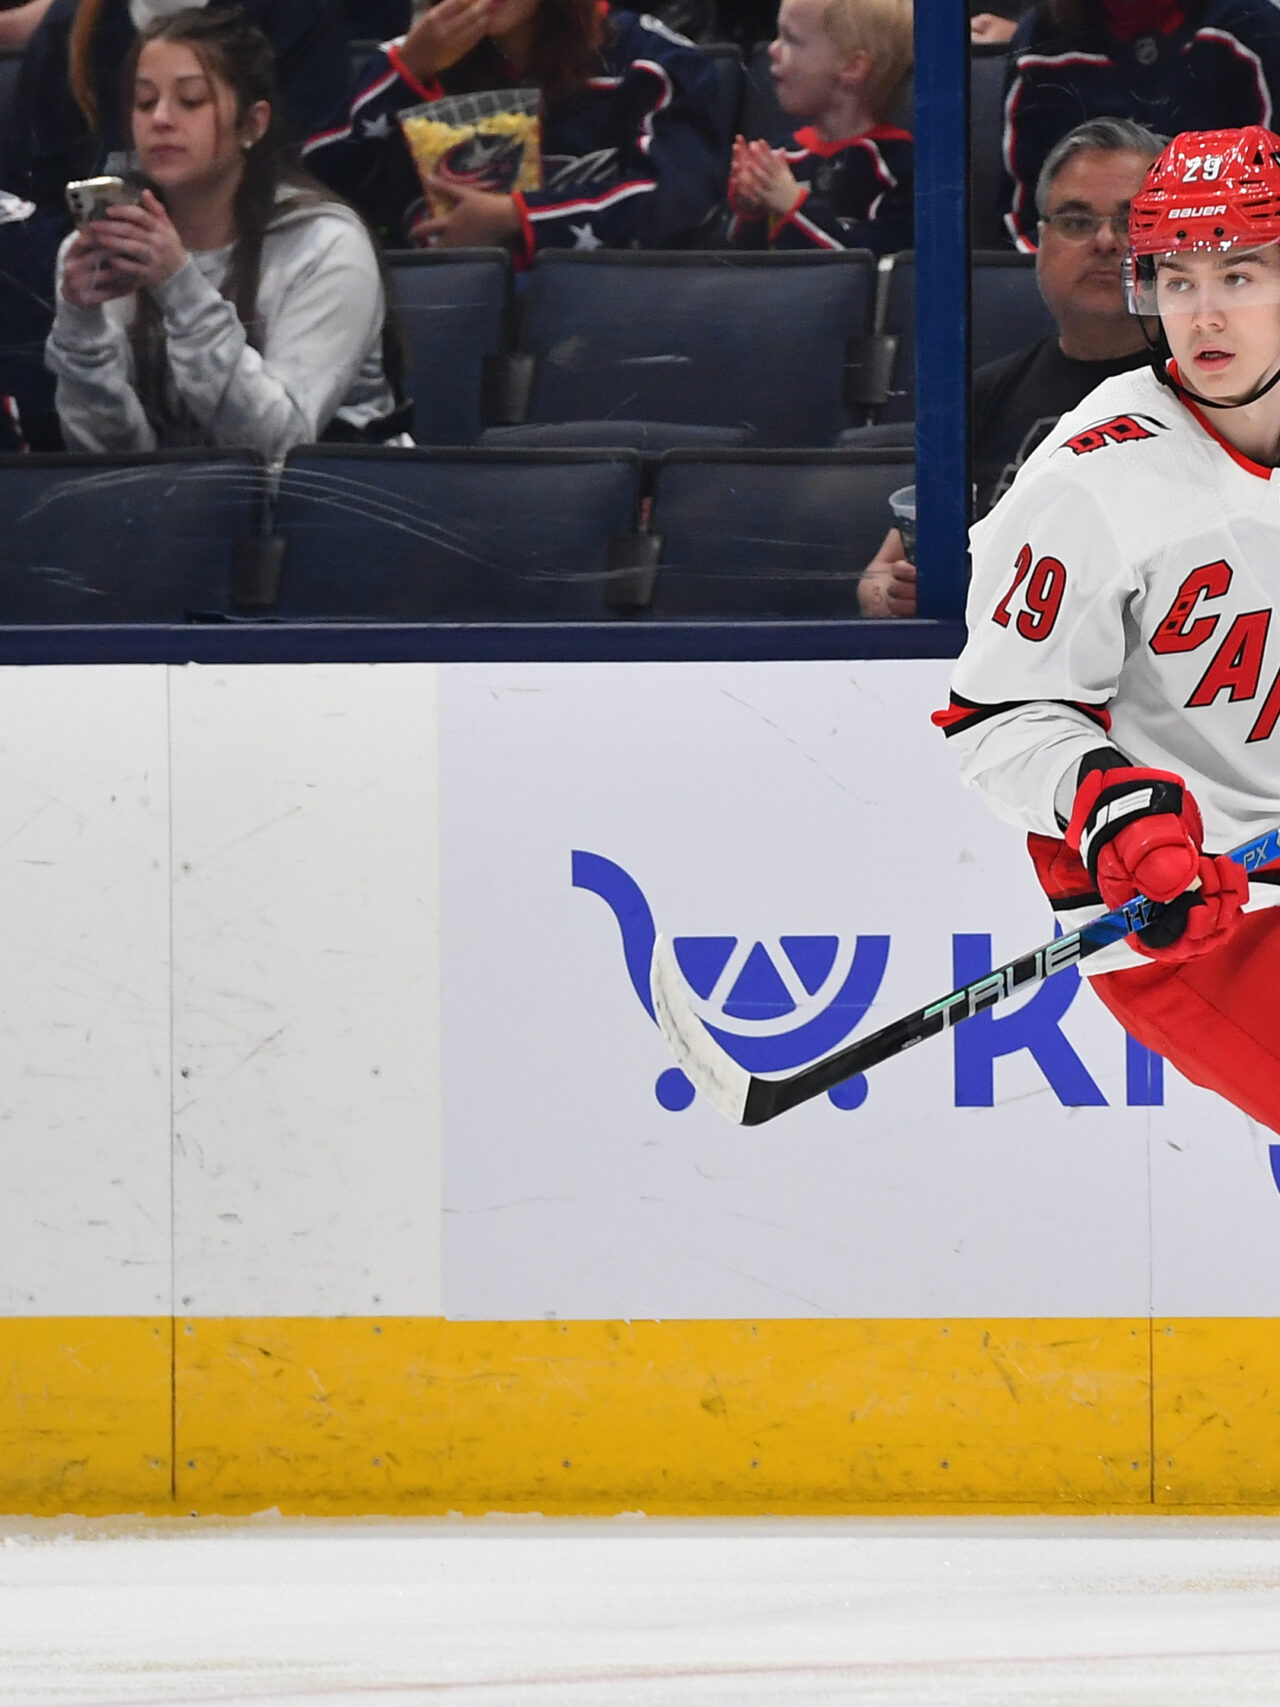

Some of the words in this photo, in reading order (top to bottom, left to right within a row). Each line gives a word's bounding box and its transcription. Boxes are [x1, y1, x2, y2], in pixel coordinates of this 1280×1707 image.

[1182, 155, 1222, 183] 29
[1168, 205, 1227, 219] BAUER
[992, 543, 1067, 642] 29
[1243, 839, 1269, 869] PX
[923, 932, 1081, 1029] TRUE
